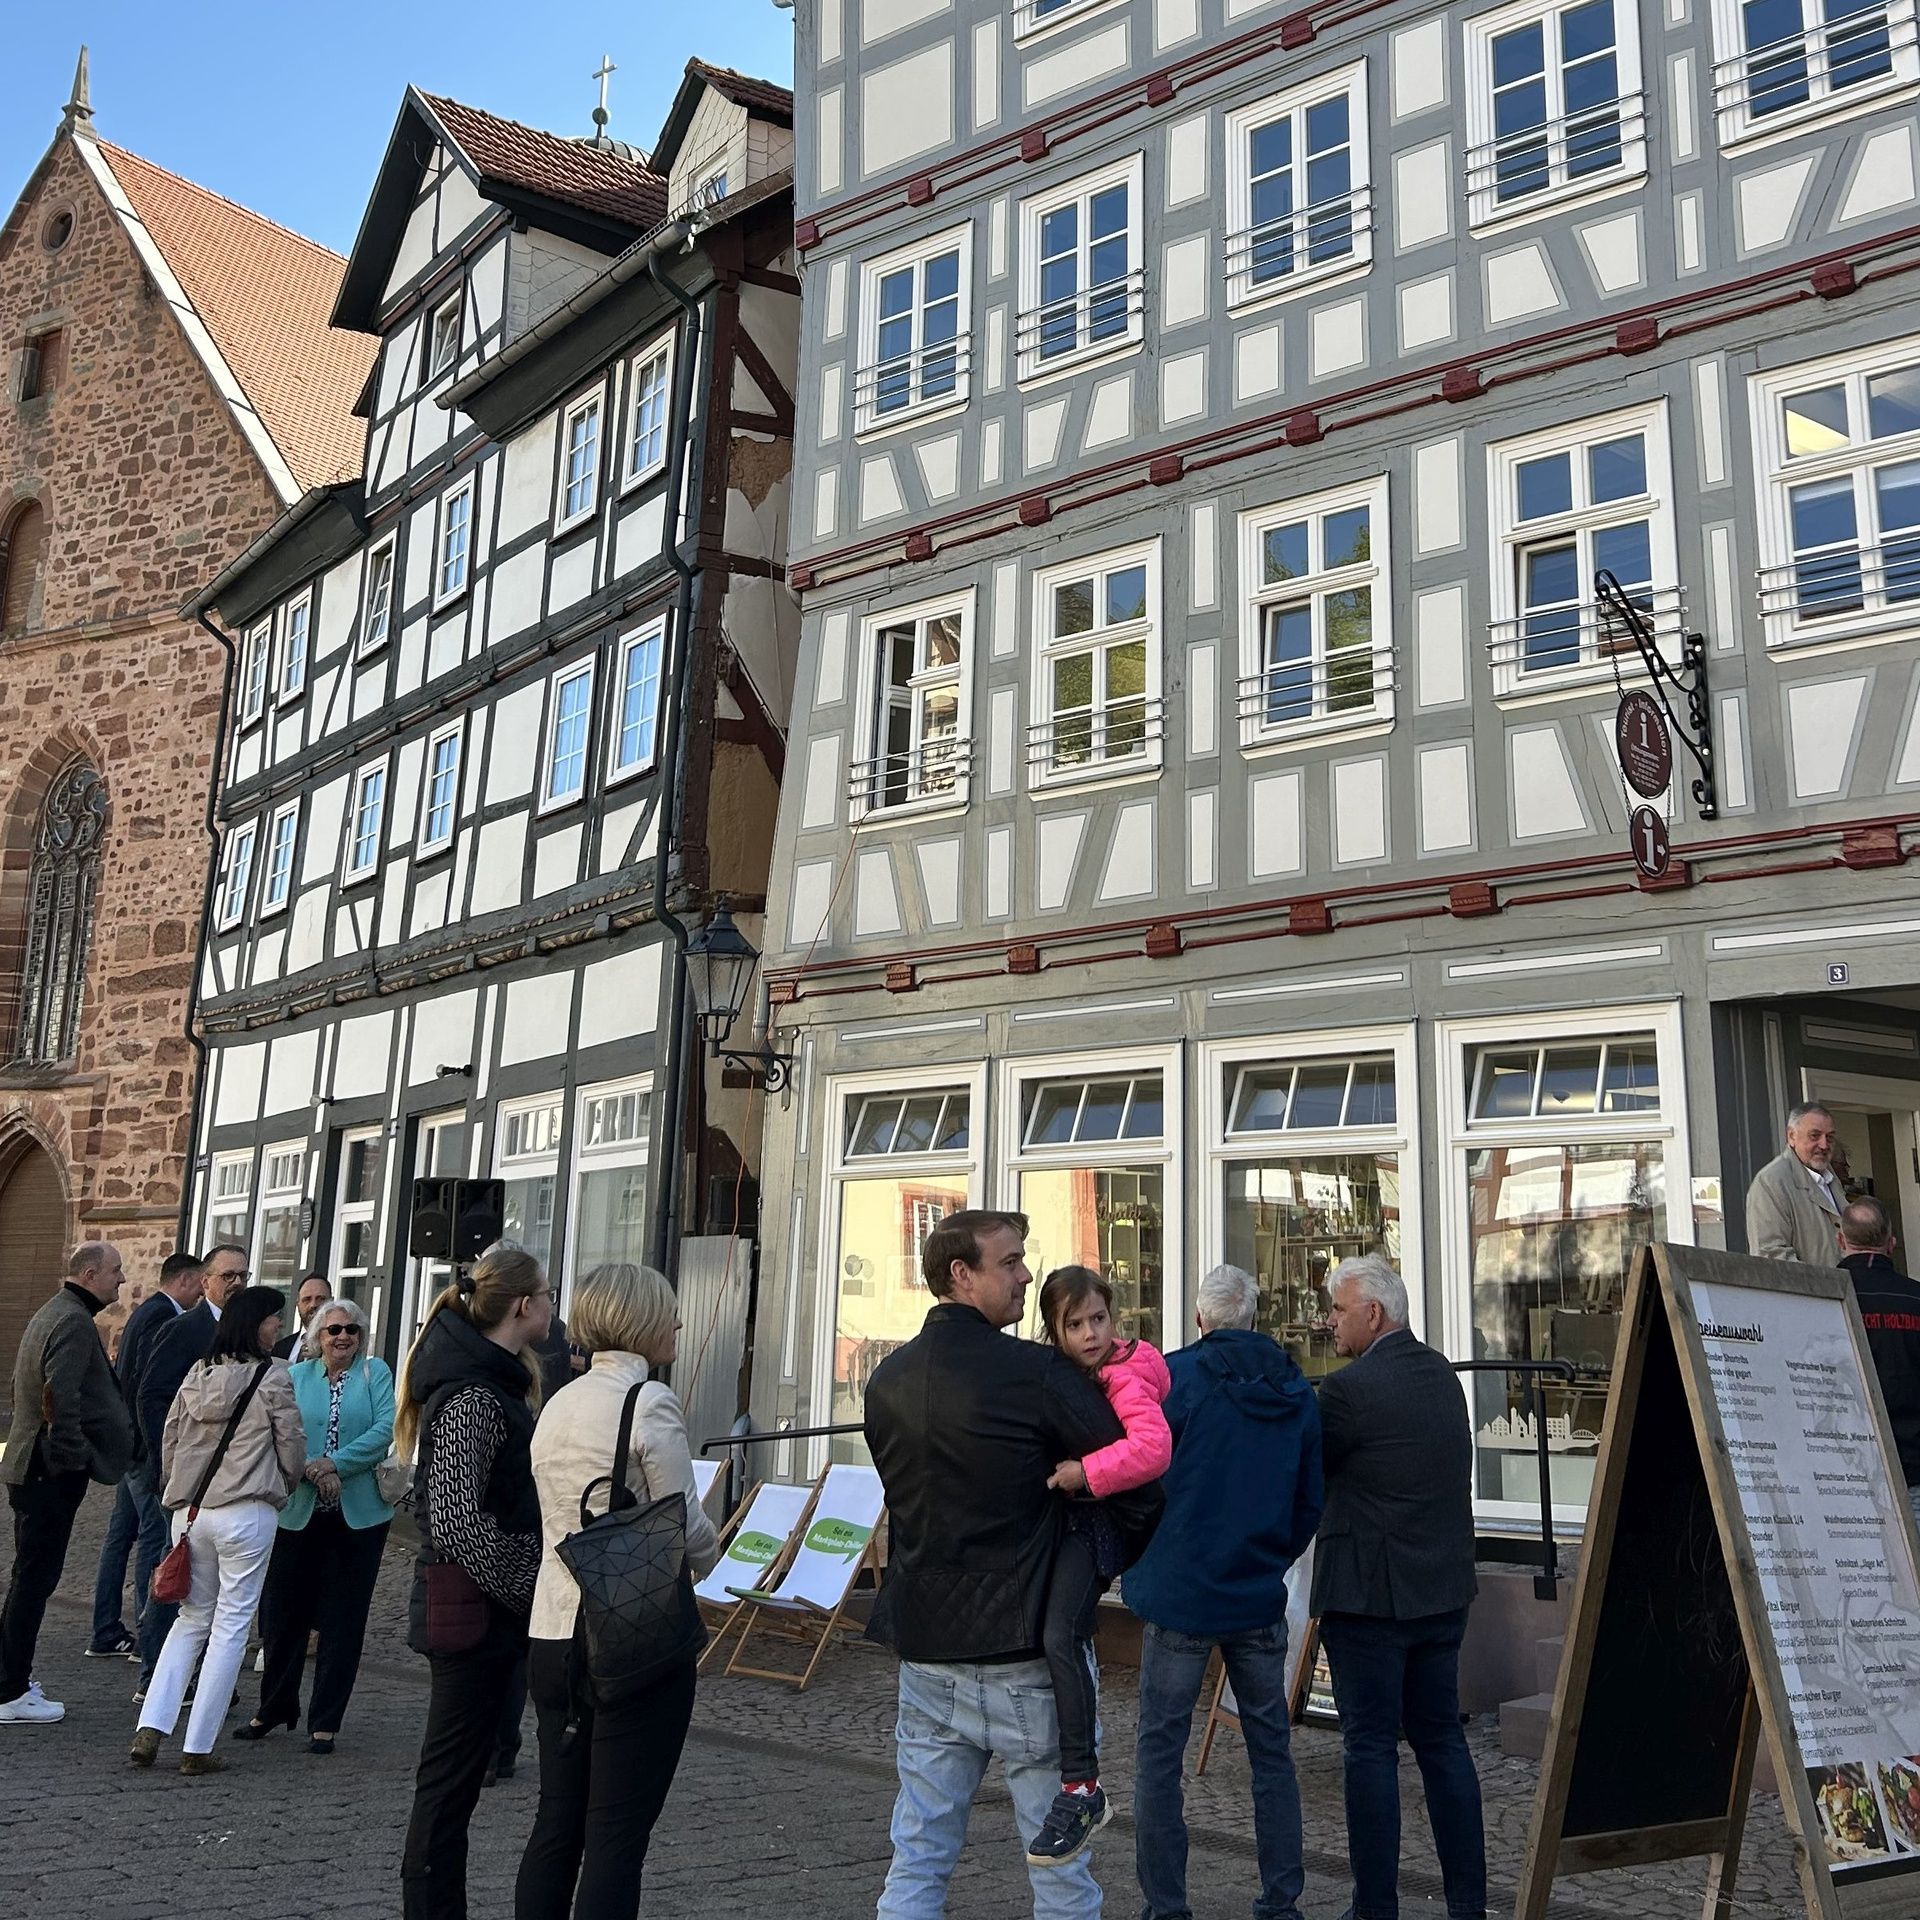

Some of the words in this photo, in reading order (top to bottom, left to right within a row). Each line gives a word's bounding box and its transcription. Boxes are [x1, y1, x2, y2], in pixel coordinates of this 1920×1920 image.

[1833, 967, 1843, 980] 3
[1793, 1515, 1804, 1525] 1/4
[1780, 1602, 1800, 1614] Burger
[1821, 1690, 1842, 1703] Burger
